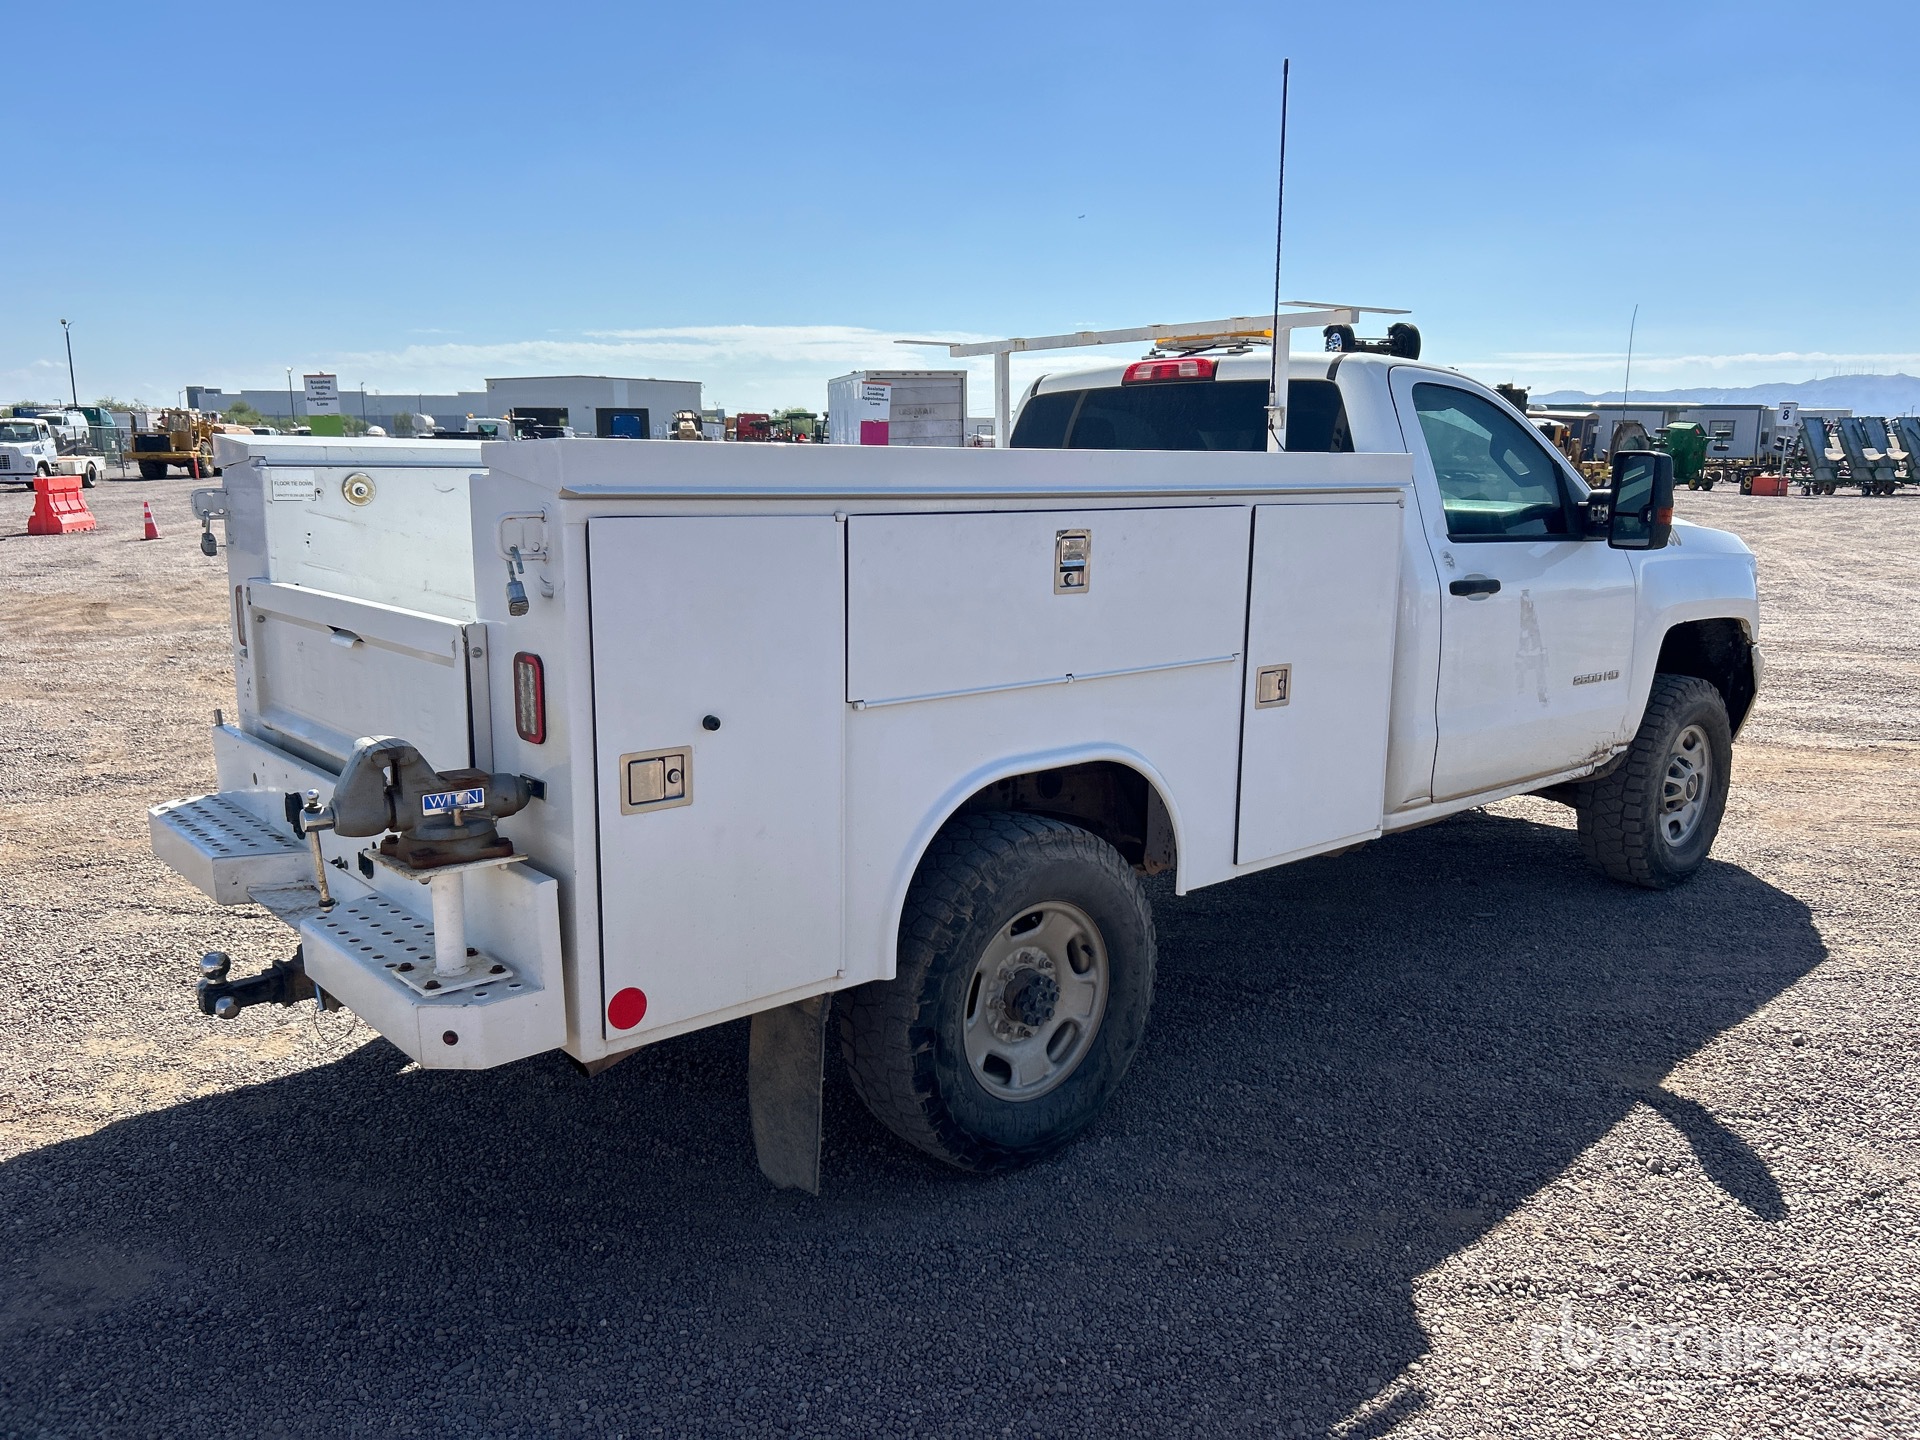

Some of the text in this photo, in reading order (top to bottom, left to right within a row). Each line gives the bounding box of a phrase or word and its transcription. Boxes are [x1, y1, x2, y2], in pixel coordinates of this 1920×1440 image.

[1782, 410, 1790, 420] 8
[1743, 476, 1752, 490] 8
[1573, 670, 1619, 686] 2500 HD
